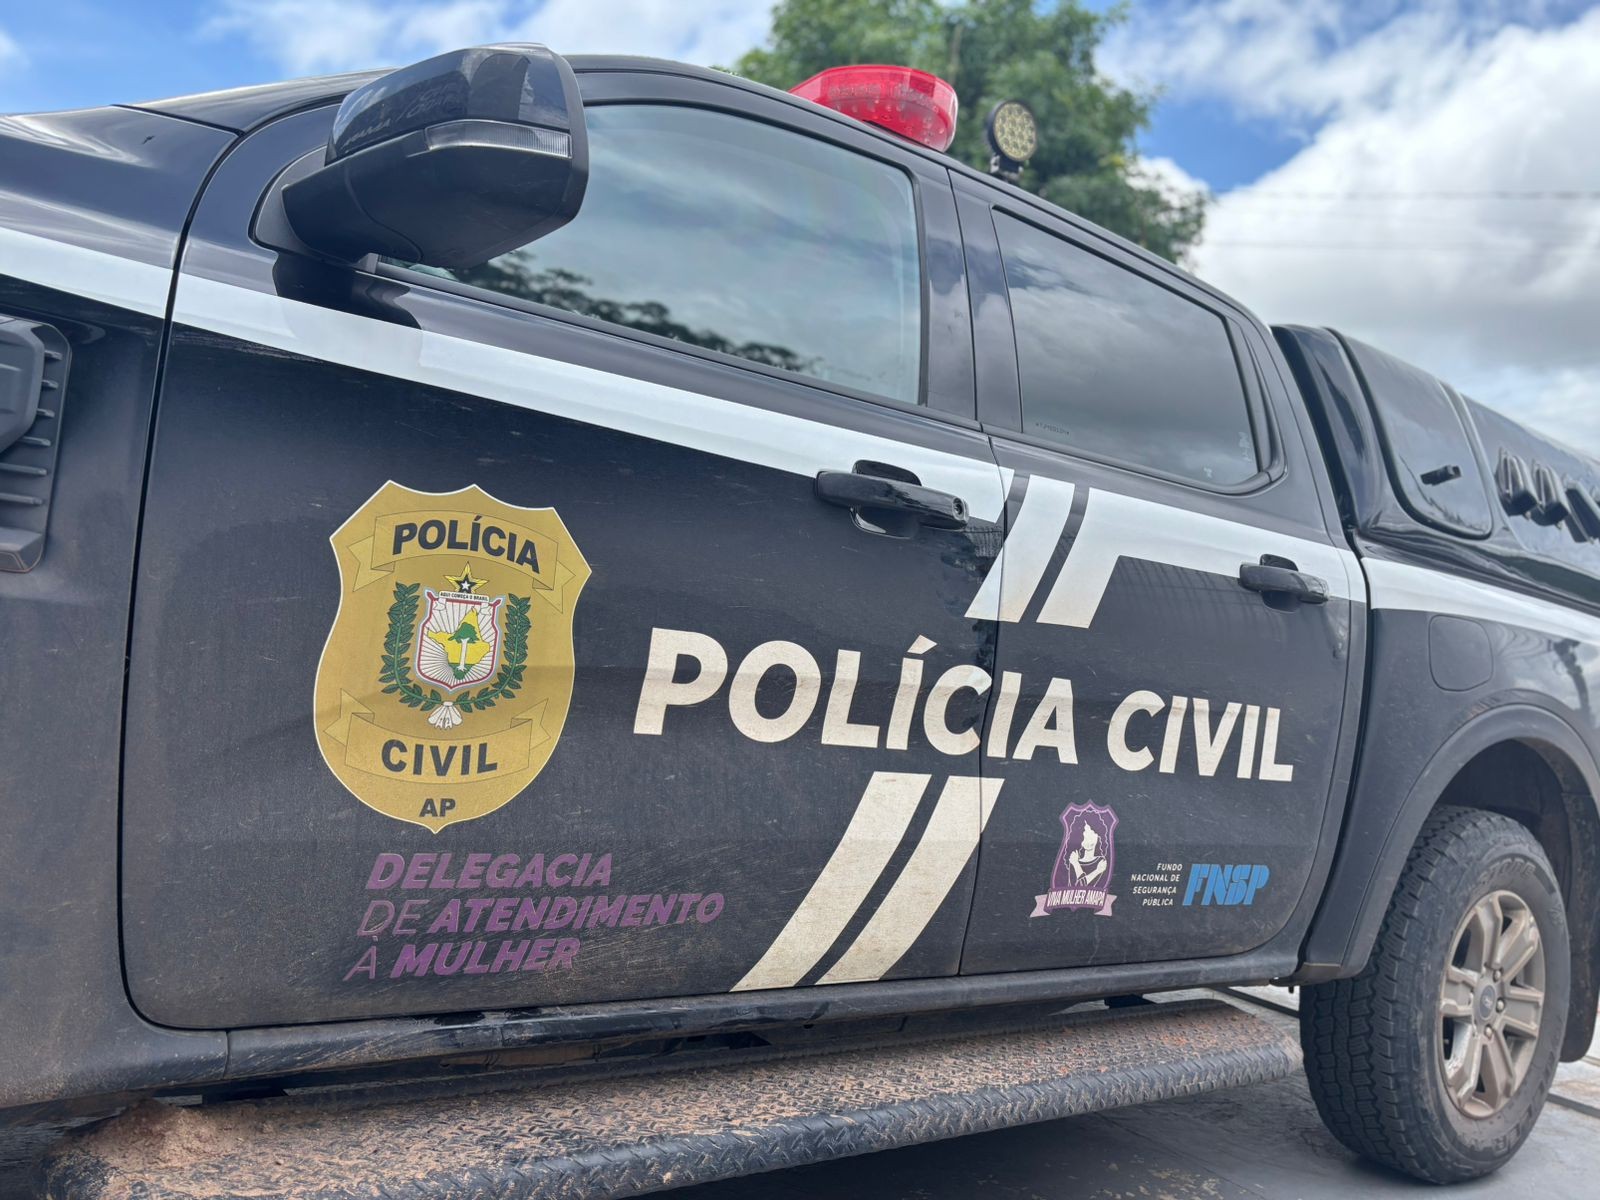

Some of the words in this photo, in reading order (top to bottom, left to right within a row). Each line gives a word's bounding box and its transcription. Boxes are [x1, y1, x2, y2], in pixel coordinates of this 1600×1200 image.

[392, 515, 540, 574] POLÍCIA
[633, 627, 1078, 765] POLÍCIA
[1106, 690, 1294, 783] CIVIL
[381, 739, 498, 777] CIVIL
[419, 798, 456, 817] AP
[365, 852, 612, 890] DELEGACIA
[1130, 873, 1169, 882] NACIONAL
[1170, 873, 1181, 882] DE
[1156, 862, 1183, 872] FUNDO
[1182, 863, 1270, 906] FNSP
[1047, 890, 1062, 907] VIVA
[1061, 889, 1087, 905] MULHER
[1132, 885, 1177, 896] SEGURANÇA
[357, 899, 428, 937] DE
[427, 892, 725, 935] ATENDIMENTO
[390, 937, 580, 979] MULHER
